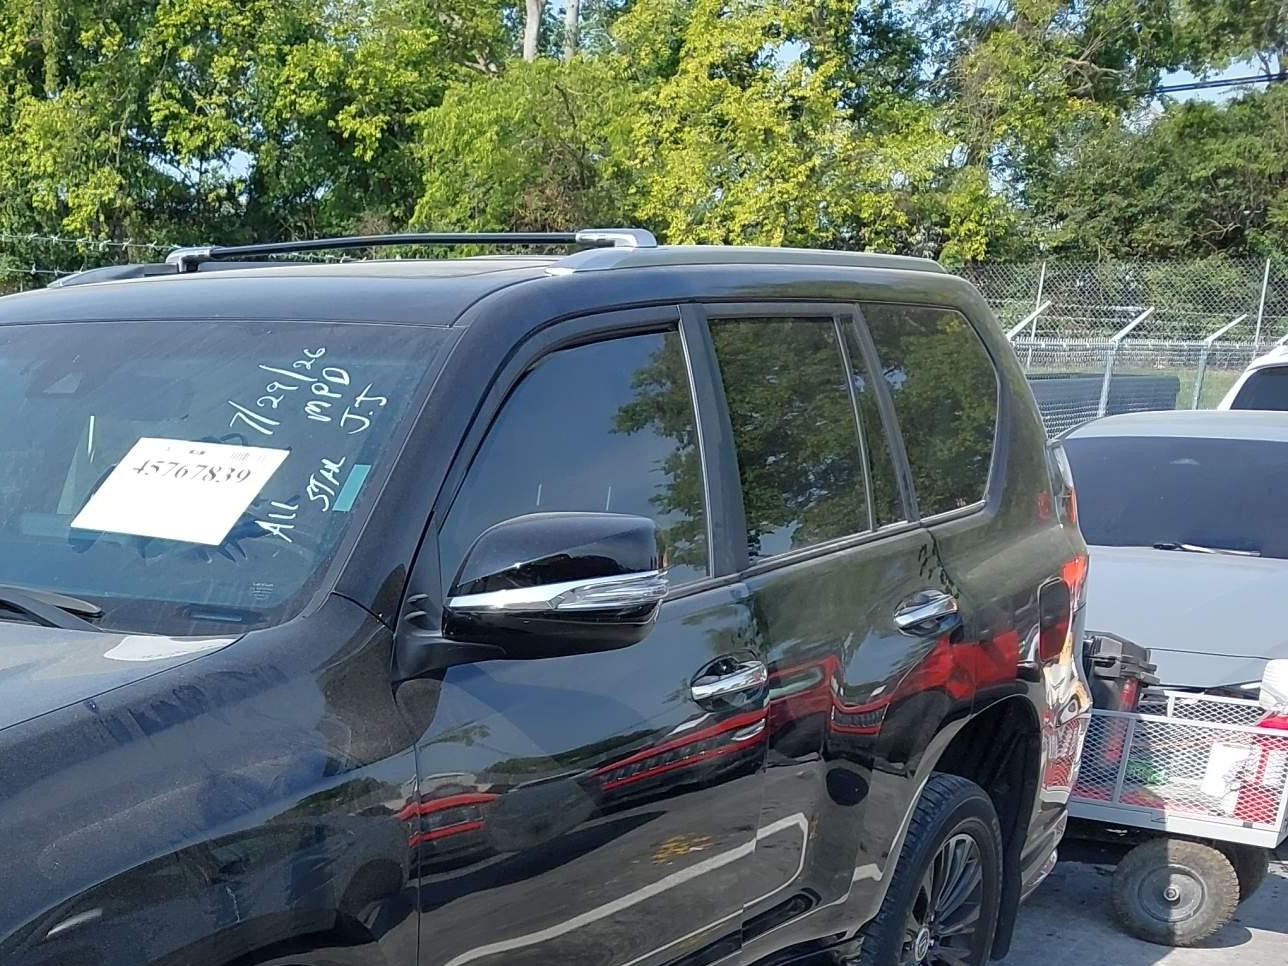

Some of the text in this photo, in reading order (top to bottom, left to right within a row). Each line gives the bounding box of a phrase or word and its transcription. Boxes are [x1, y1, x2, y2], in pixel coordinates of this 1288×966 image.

[228, 347, 326, 435] 7/29/26
[304, 367, 350, 422] MPD
[132, 459, 252, 484] 45767839
